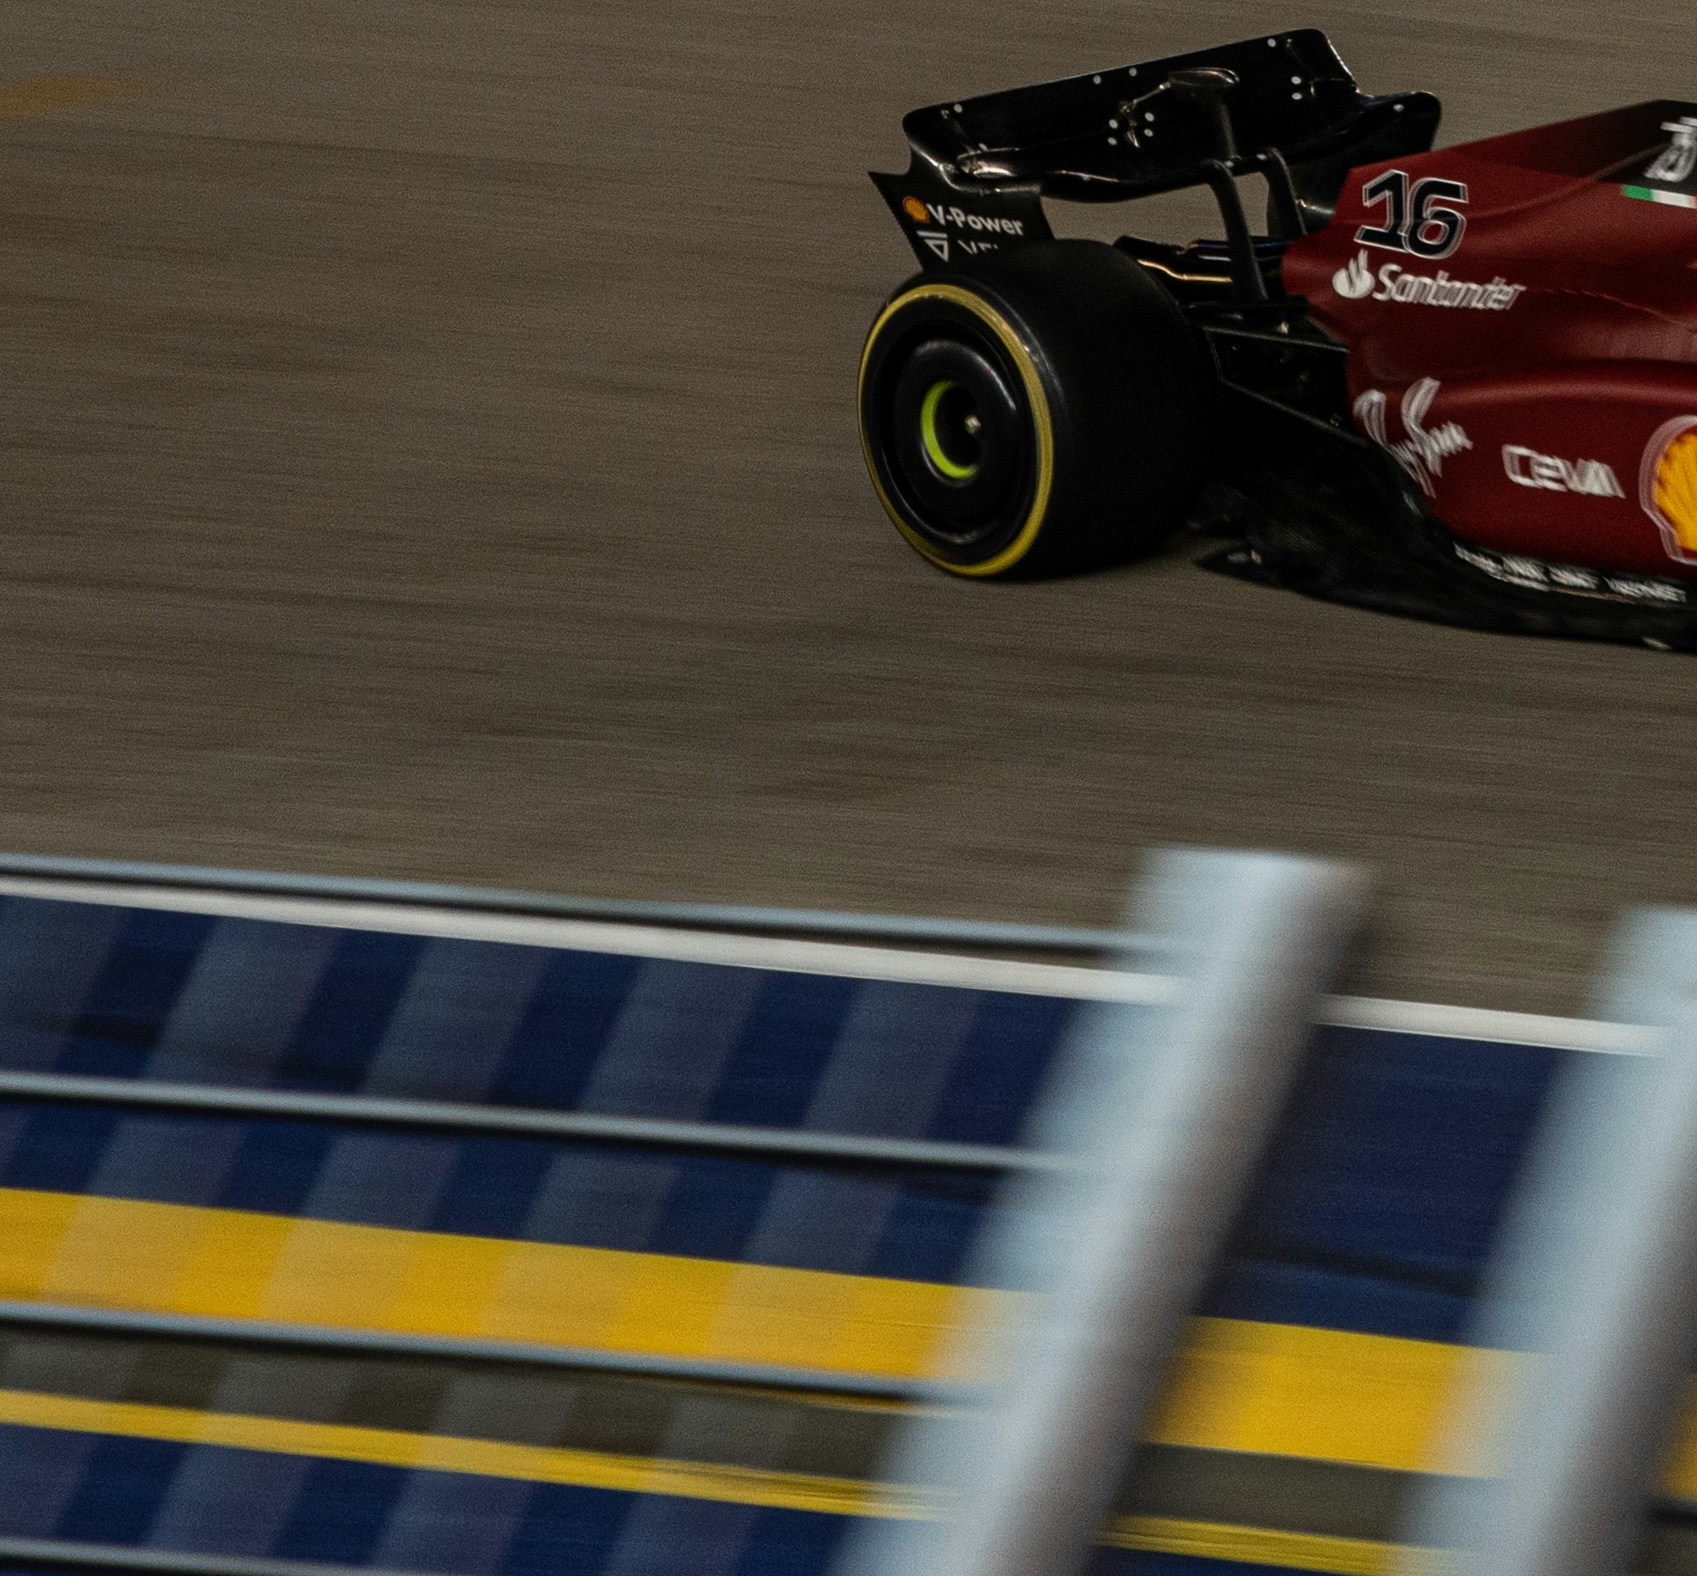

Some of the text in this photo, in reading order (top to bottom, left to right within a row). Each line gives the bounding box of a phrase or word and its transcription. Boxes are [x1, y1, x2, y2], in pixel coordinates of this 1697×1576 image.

[926, 202, 1024, 236] V-Power
[1353, 169, 1470, 260] 16
[1372, 262, 1528, 310] Santander
[1501, 443, 1628, 499] CEVA
